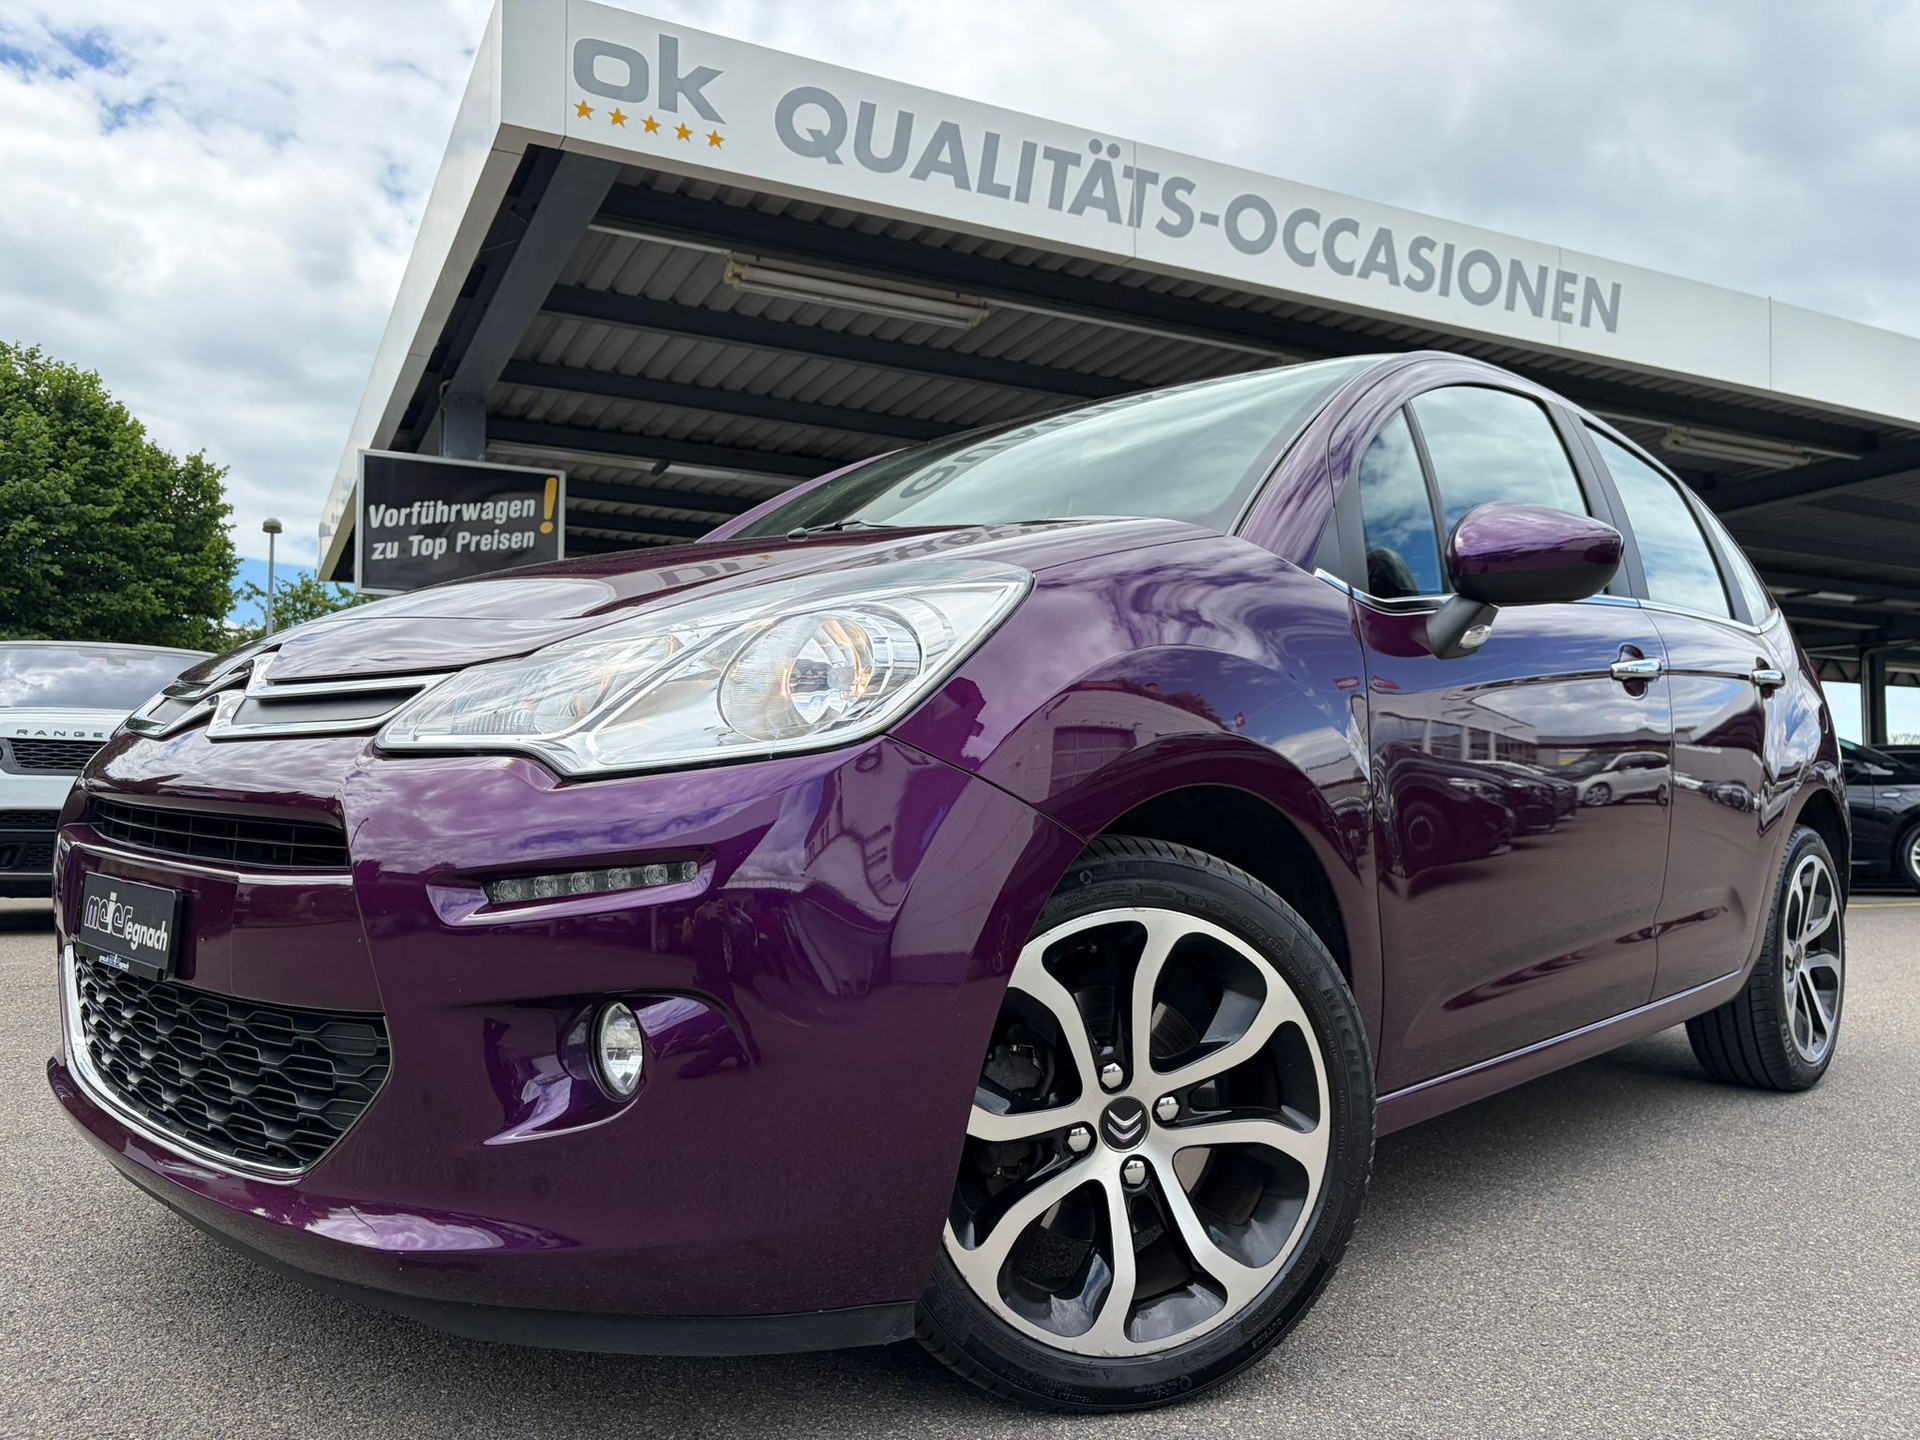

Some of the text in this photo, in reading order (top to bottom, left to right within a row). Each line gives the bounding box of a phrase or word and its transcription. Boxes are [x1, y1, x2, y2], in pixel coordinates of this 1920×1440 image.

[573, 33, 1622, 333] ok QUALITÄTS-OCCASIONEN
[369, 499, 536, 529] Vorführwagen
[371, 529, 535, 560] zu Top Preisen
[16, 729, 104, 738] RANGE
